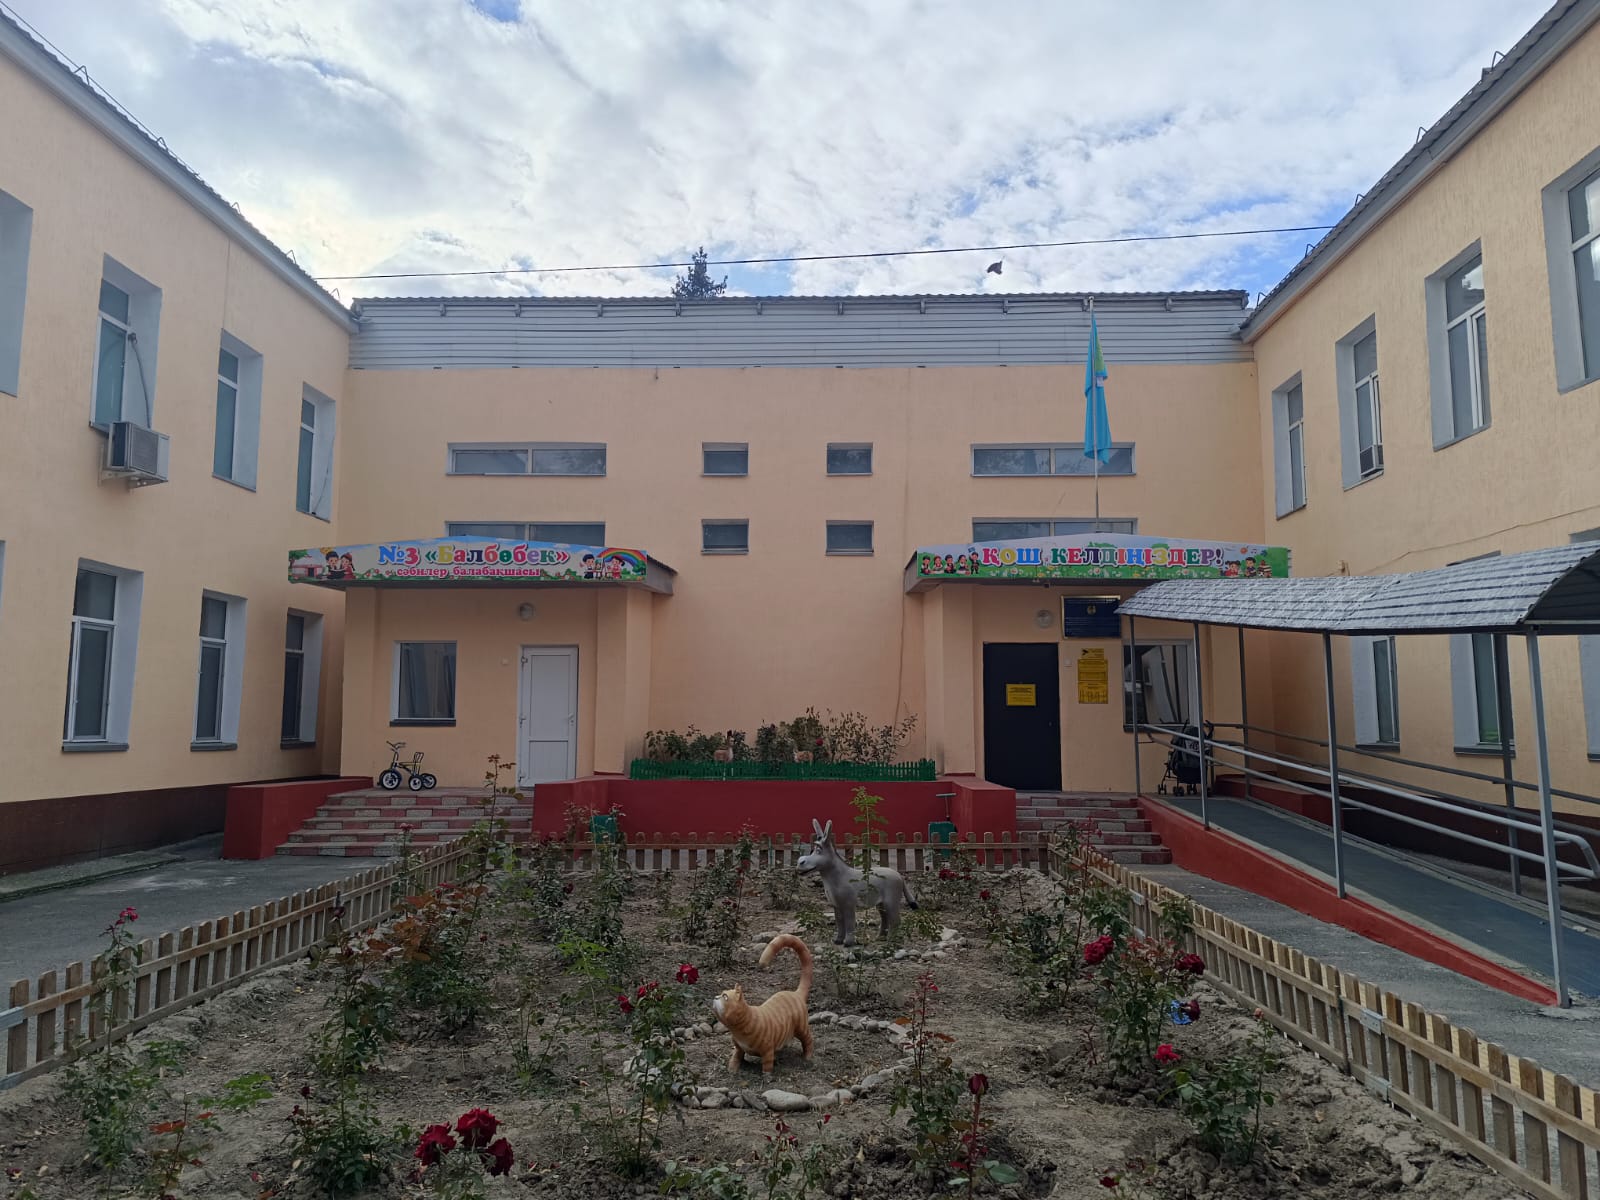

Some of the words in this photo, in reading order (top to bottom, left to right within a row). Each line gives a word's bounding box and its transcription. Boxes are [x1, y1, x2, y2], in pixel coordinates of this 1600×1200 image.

[378, 545, 420, 565] №3
[425, 543, 568, 563] «Балбөбек»
[982, 548, 1041, 566] ҚОШ
[1051, 548, 1221, 566] КЕЛДІҢІЗДЕР!
[397, 567, 447, 578] сәбилер
[453, 566, 540, 577] балабақшасы
